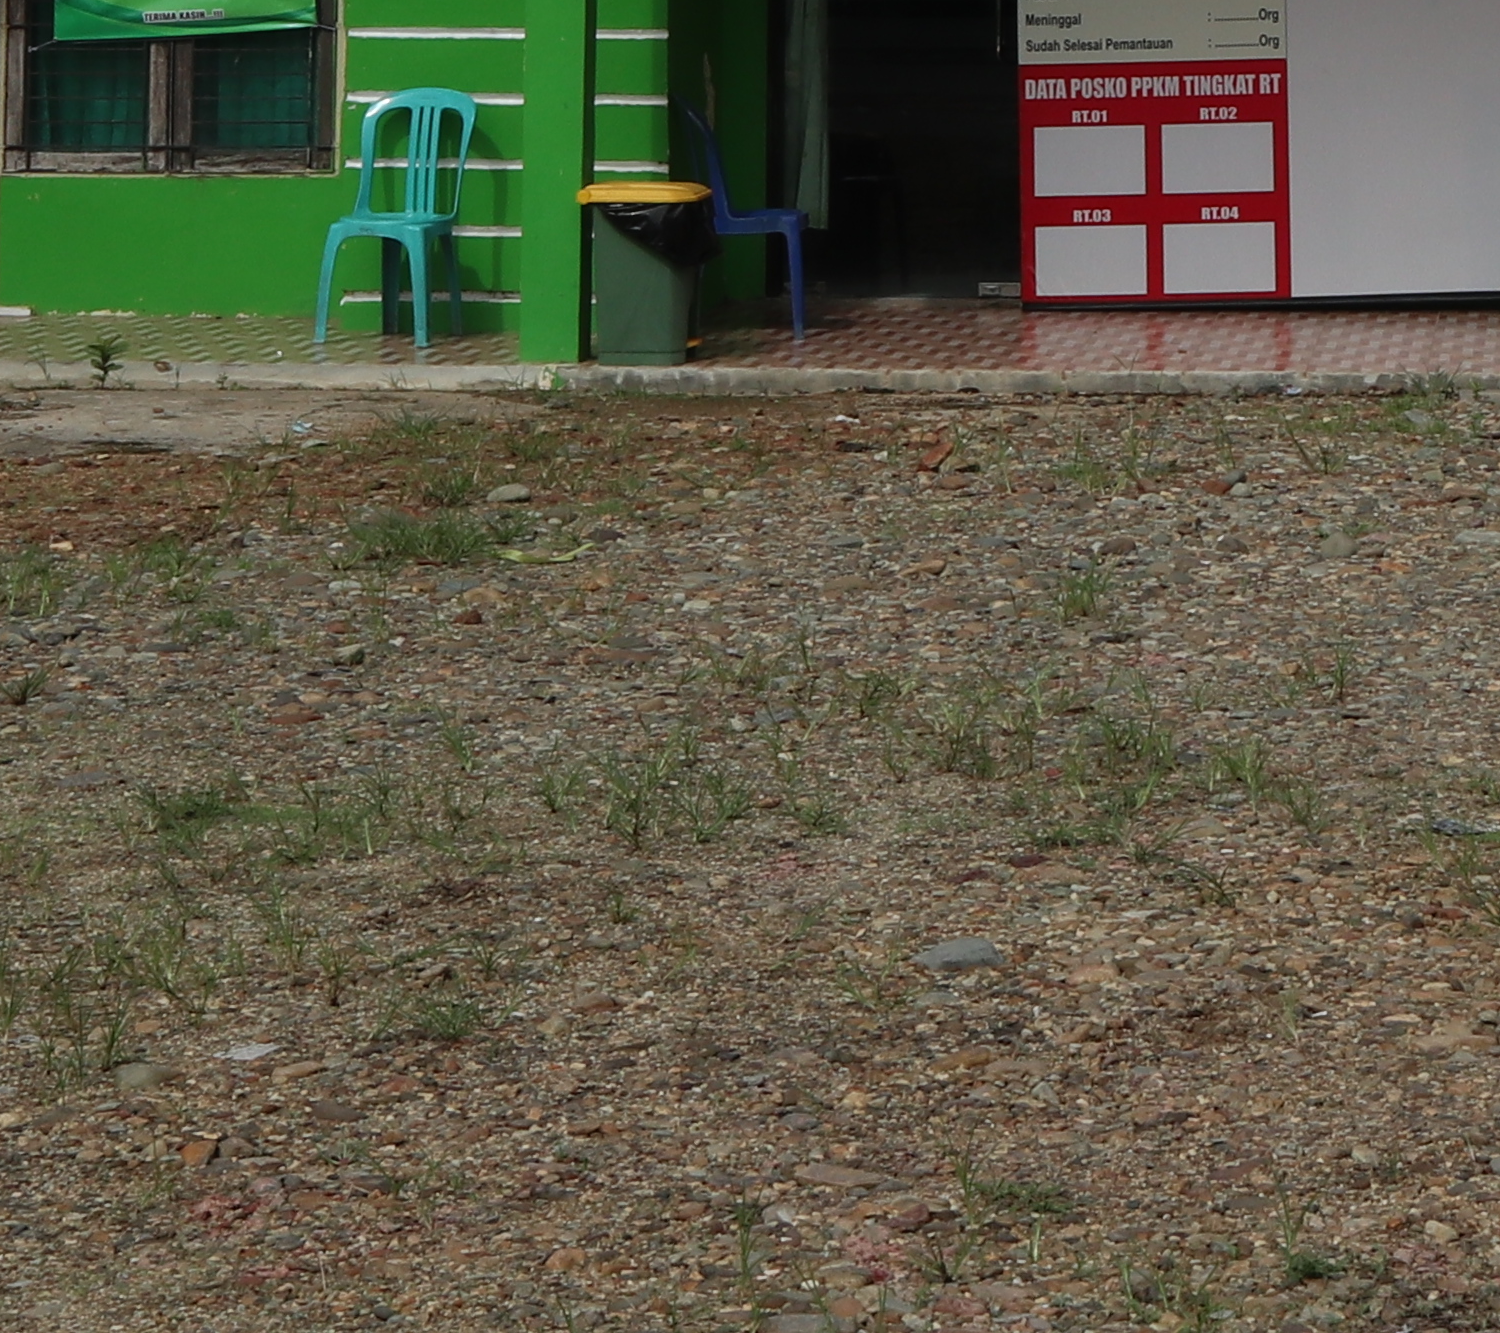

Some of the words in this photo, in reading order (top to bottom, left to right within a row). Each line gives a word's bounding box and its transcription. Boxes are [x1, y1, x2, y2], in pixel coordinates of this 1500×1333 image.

[144, 13, 176, 22] TERIMA
[1025, 13, 1081, 28] Meninggal
[1026, 40, 1060, 52] Sudah
[1063, 39, 1102, 51] Selesai
[1106, 38, 1173, 50] Pemantauan
[1025, 78, 1066, 99] DATA
[1071, 77, 1127, 99] POSKO
[1131, 76, 1179, 98] PPKM
[1183, 74, 1255, 96] TINGKAT
[1259, 73, 1281, 94] RT
[1072, 110, 1107, 123] RT.01
[1200, 107, 1237, 120] RT.02
[1073, 209, 1111, 222] RT.03
[1201, 206, 1239, 220] RT.04
